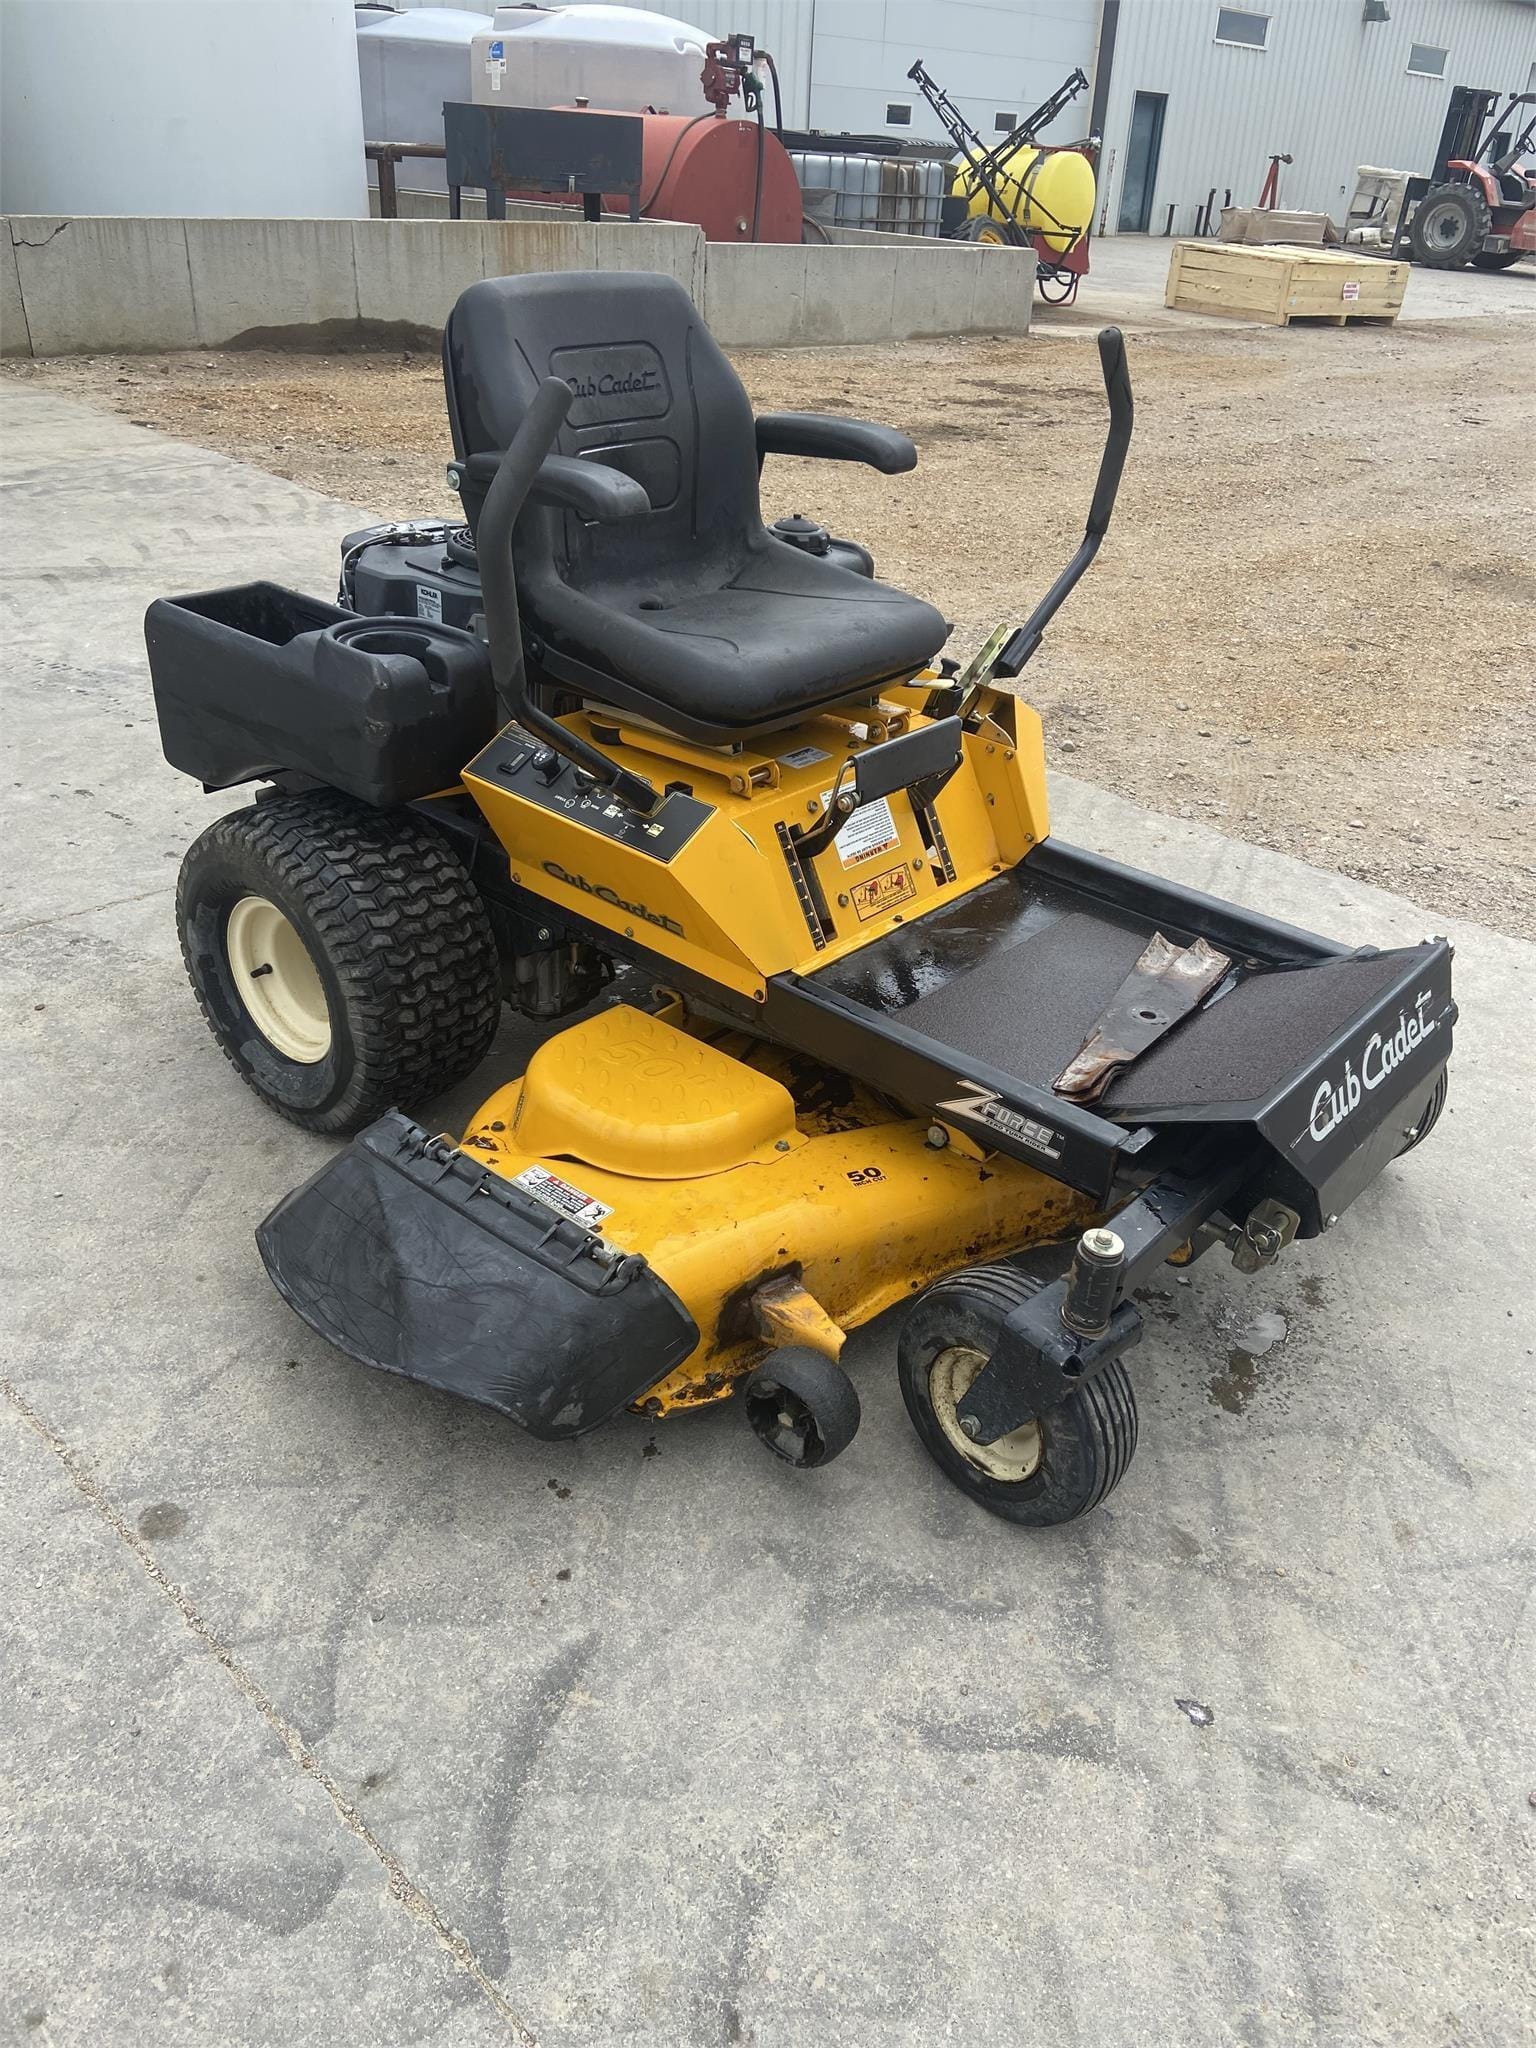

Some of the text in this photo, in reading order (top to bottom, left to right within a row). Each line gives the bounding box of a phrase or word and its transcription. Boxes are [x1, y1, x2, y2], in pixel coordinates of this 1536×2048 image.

[598, 370, 657, 396] Cadet
[855, 846, 882, 862] WARNING
[542, 860, 687, 939] Cub Cadet
[1310, 990, 1434, 1142] Cub Cadet
[986, 1118, 1047, 1152] ZERO TURN RIDER
[846, 1167, 882, 1182] 50
[853, 1175, 888, 1188] INCH CUT
[560, 1182, 589, 1201] DANGER
